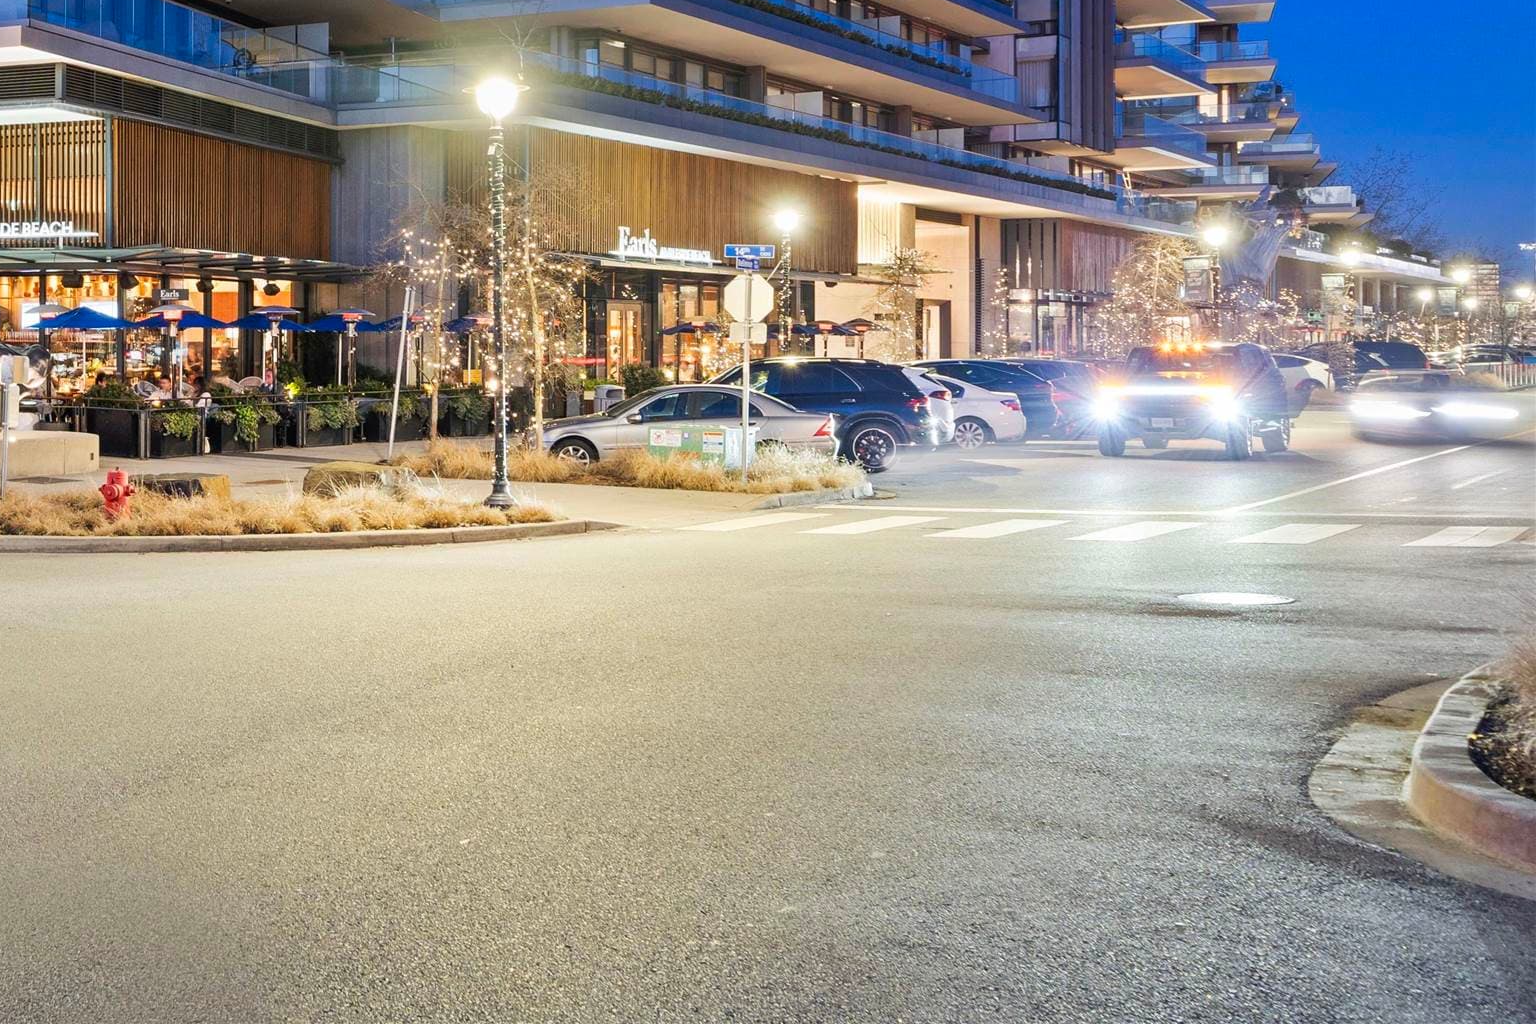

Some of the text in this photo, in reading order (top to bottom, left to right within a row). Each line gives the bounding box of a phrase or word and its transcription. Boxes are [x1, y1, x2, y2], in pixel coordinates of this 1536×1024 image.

[21, 221, 73, 236] BEACH
[618, 226, 657, 257] Earls
[160, 289, 180, 298] Earls
